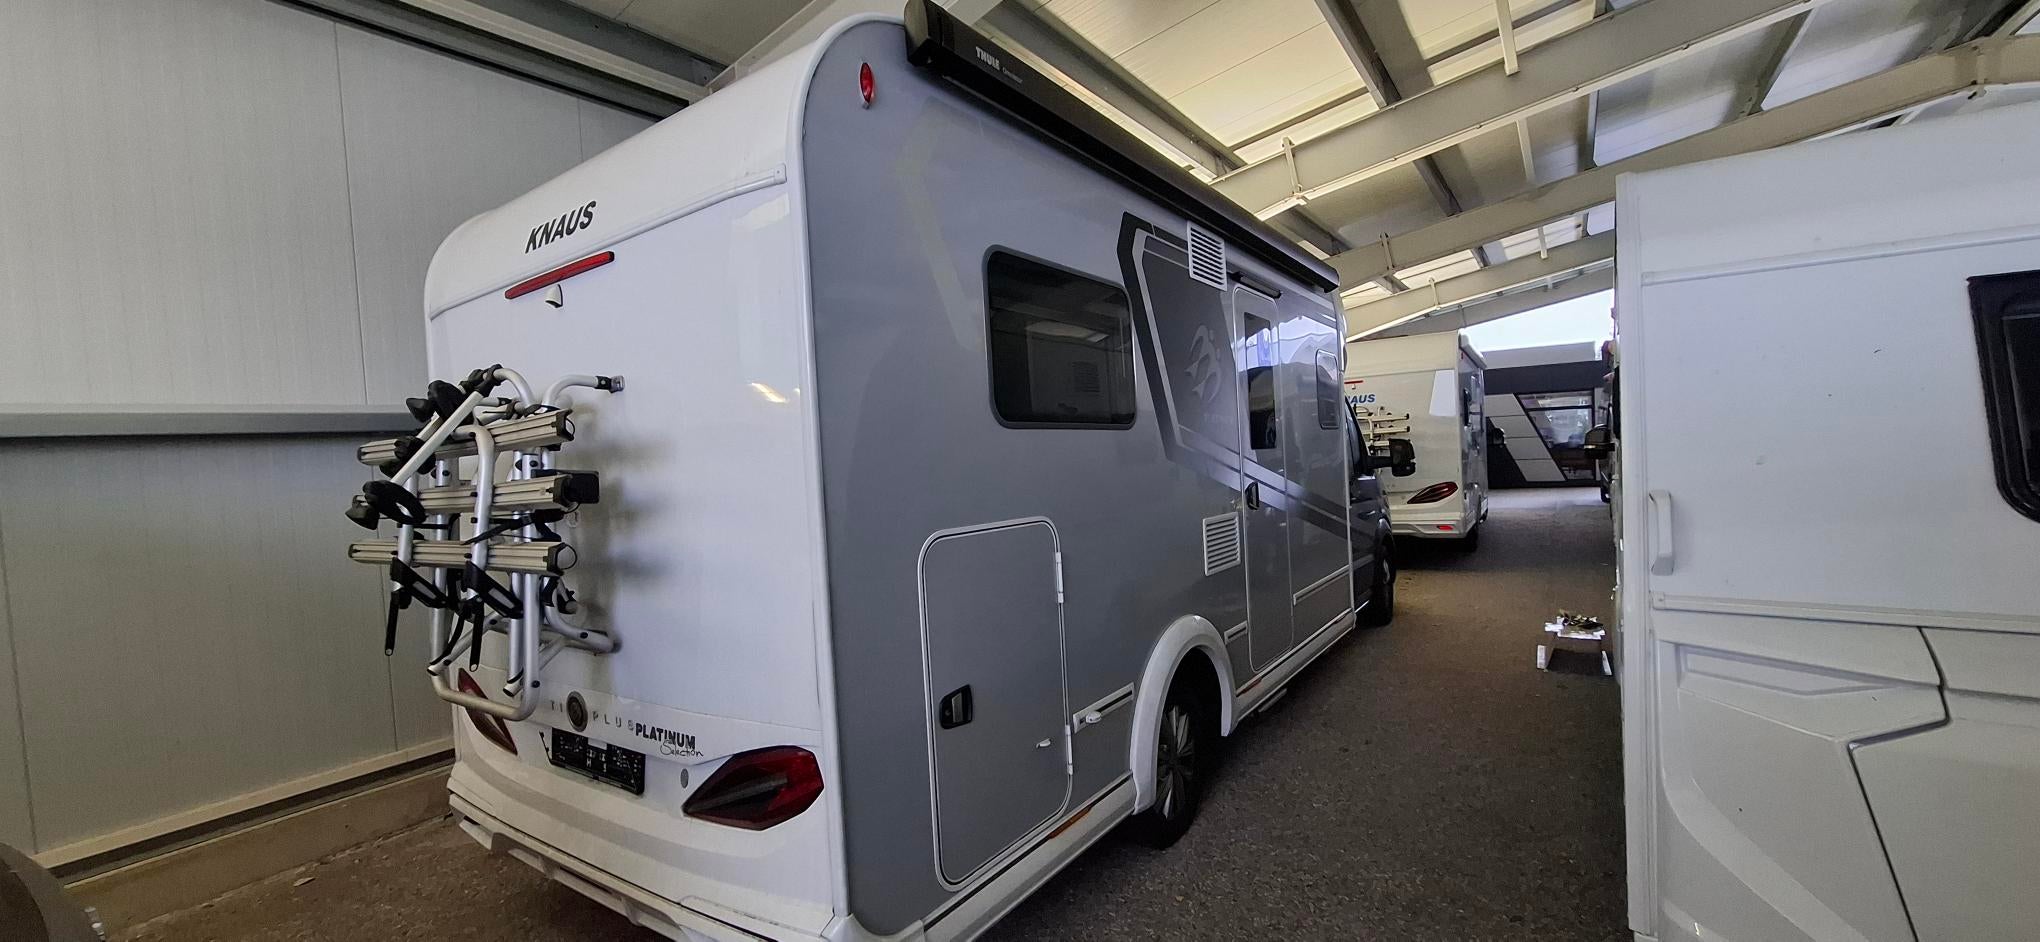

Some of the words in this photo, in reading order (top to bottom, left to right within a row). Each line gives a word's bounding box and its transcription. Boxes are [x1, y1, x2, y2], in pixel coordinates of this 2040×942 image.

[975, 46, 1000, 71] THULE
[525, 200, 597, 254] KNAUS
[1347, 393, 1376, 404] AUS
[635, 722, 695, 750] PLATINUM
